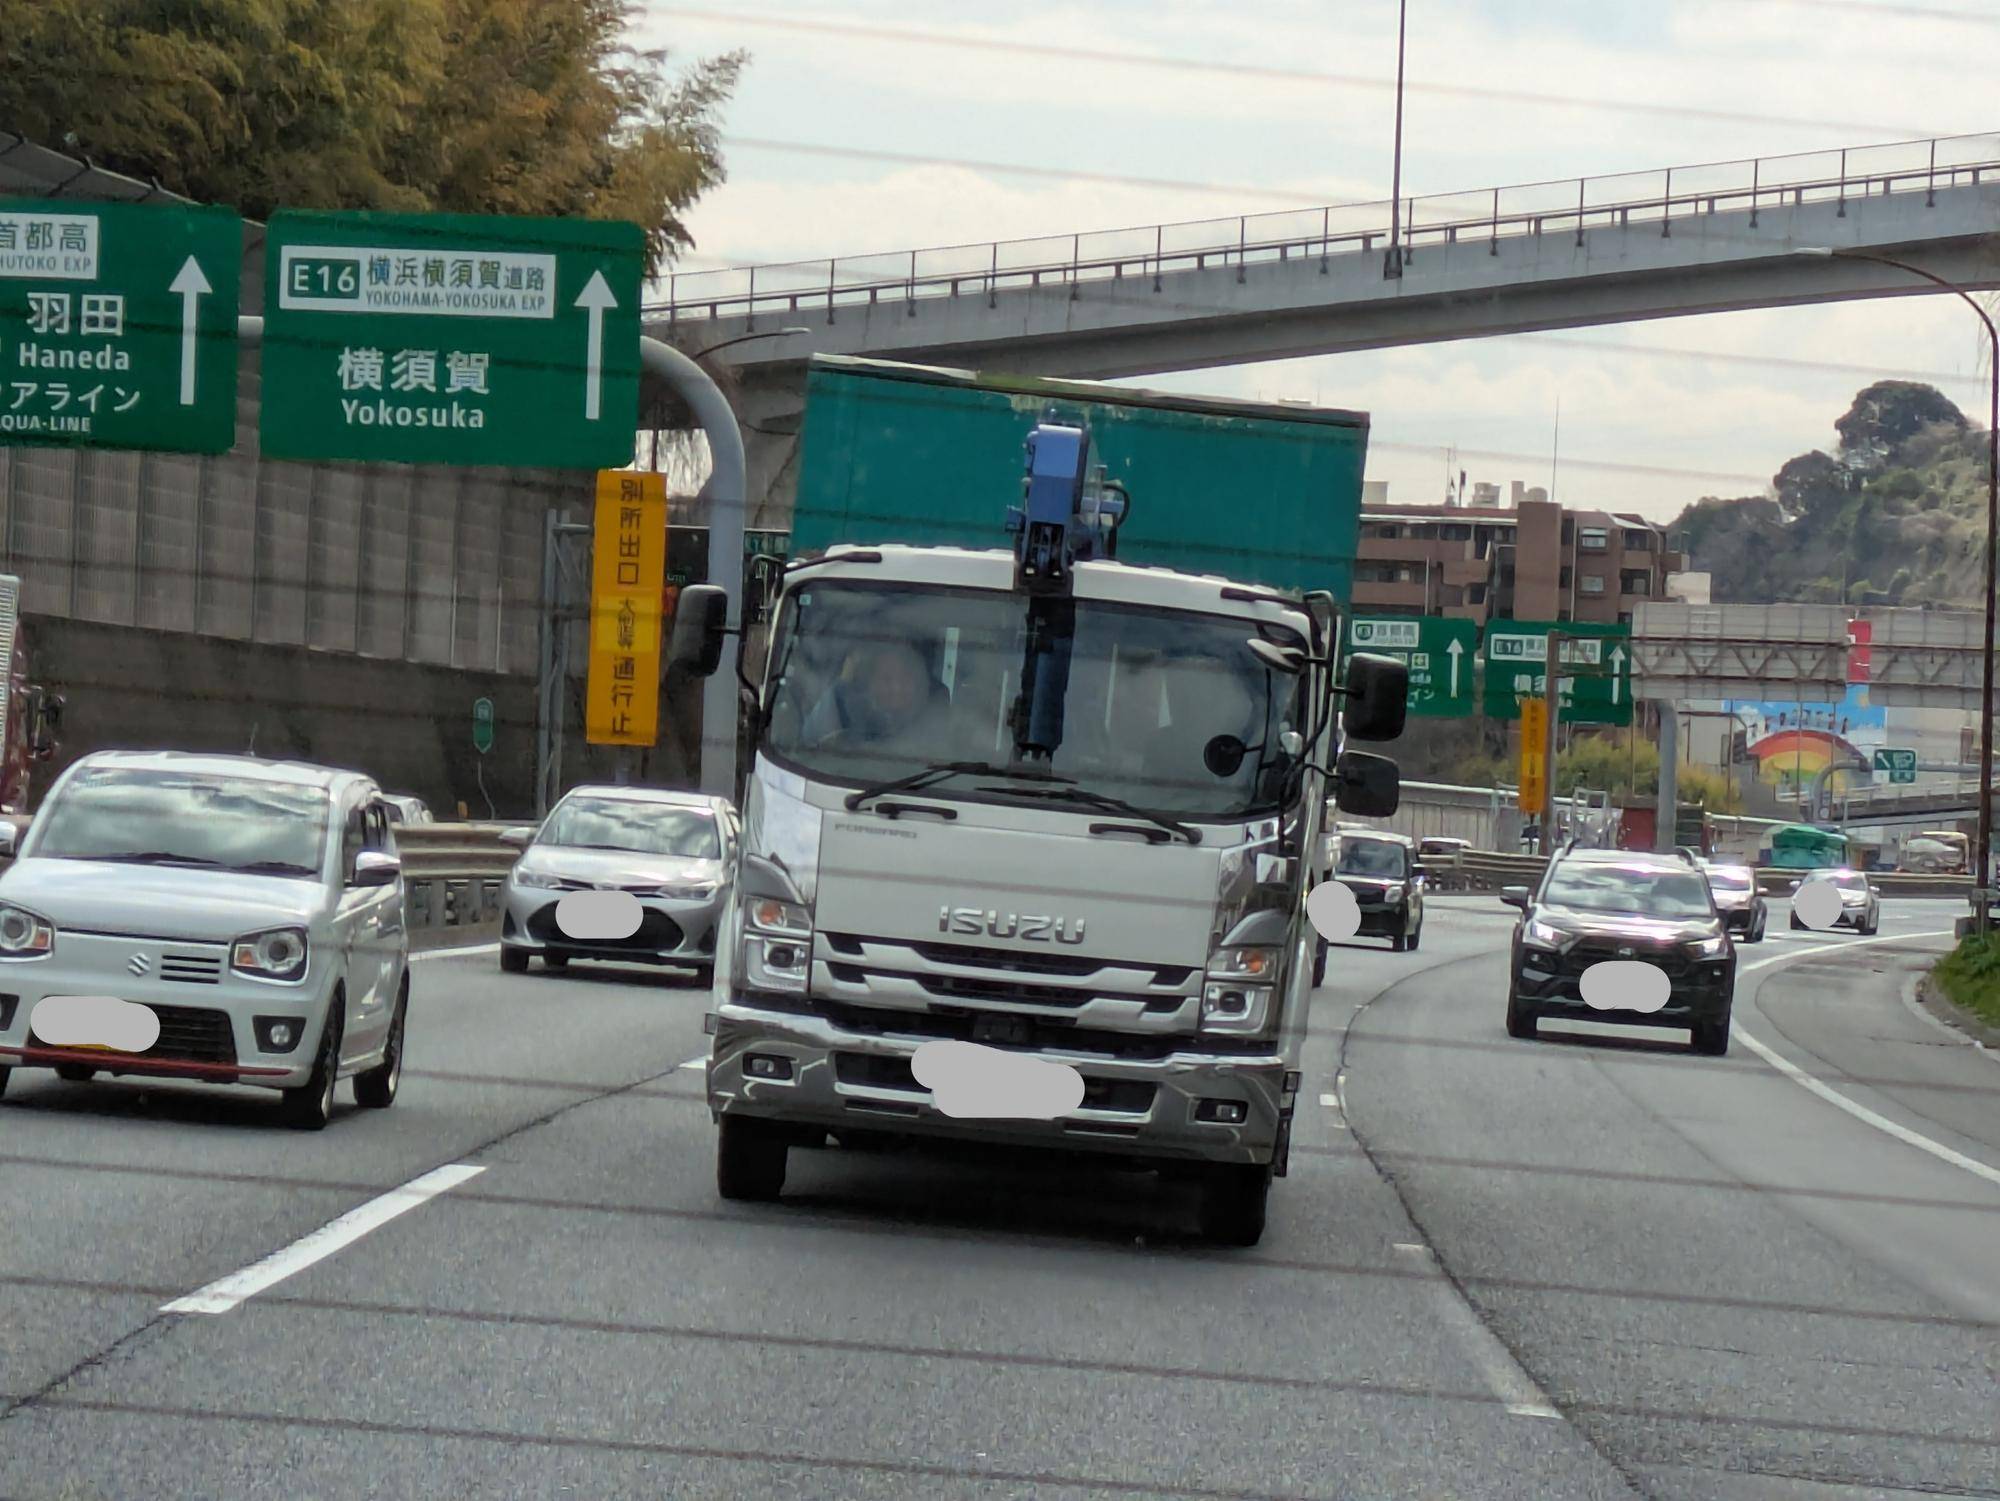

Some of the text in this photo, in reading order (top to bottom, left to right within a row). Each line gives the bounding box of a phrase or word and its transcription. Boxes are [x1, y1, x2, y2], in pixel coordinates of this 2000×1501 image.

[0, 254, 92, 272] UTOKO EXP
[293, 264, 356, 293] E16
[366, 254, 545, 292] 横浜横須賀道路
[26, 291, 124, 336] 羽田
[365, 289, 546, 311] YOKOHAMA-YOKOSUKA EXP
[19, 342, 130, 371] Haneda
[336, 346, 490, 395] 横須賀
[0, 382, 140, 414] アライン
[341, 398, 484, 429] Yokosuka
[938, 905, 1086, 945] ISUZU
